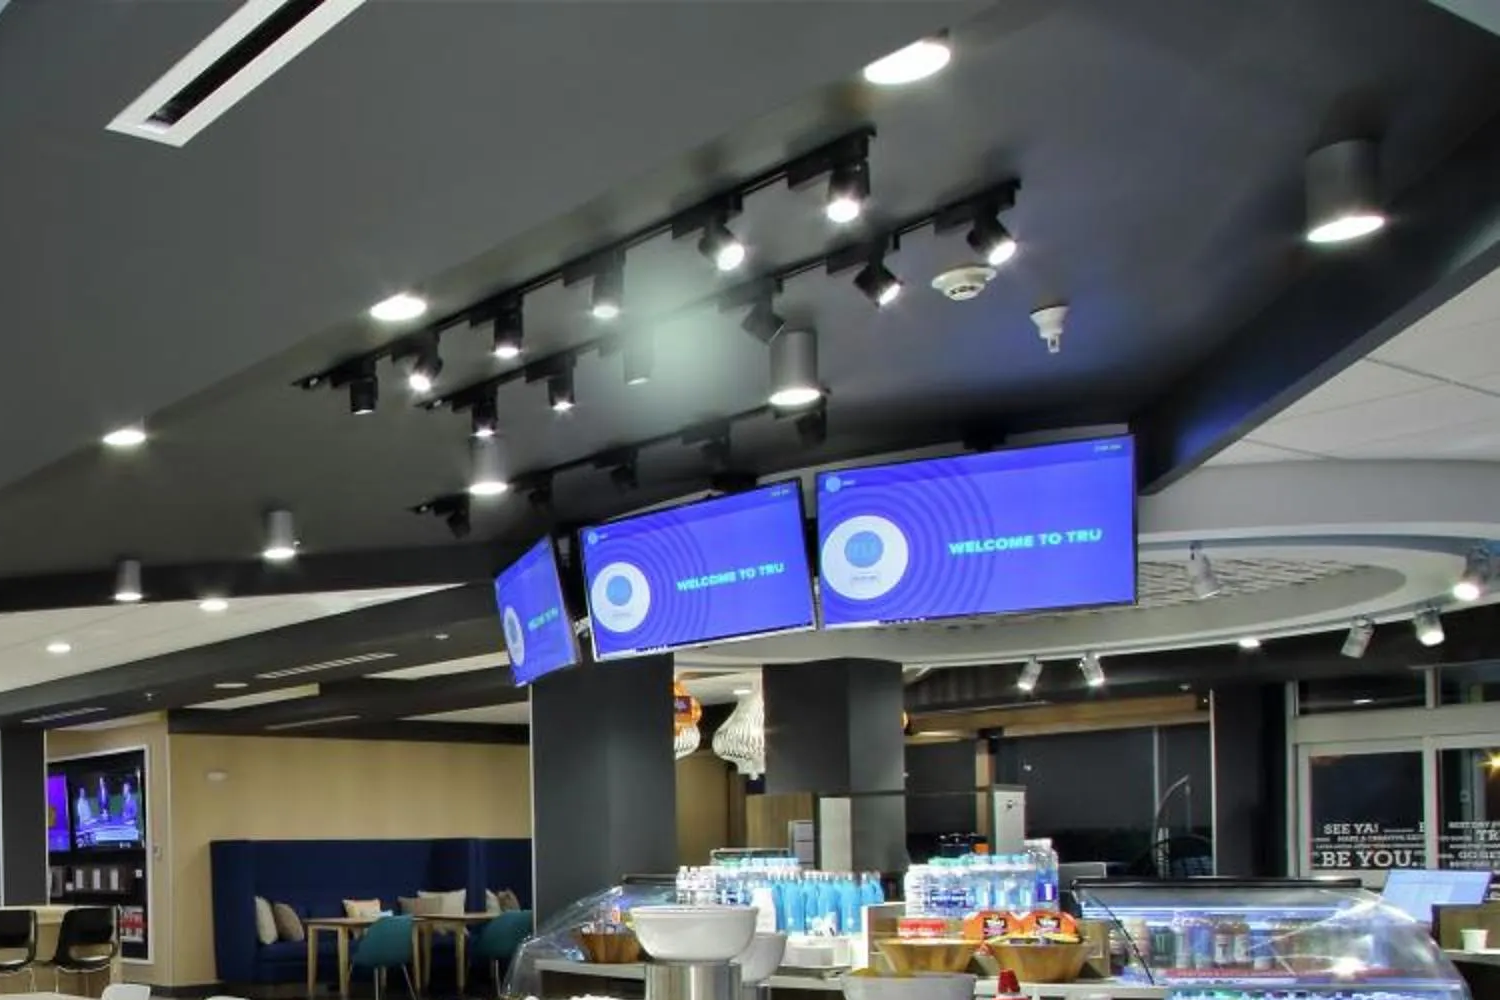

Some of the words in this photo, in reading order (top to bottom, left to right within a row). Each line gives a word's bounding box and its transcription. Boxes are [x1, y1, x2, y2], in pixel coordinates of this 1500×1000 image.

[949, 534, 1033, 555] WELCOME
[1040, 532, 1062, 546] TO
[1068, 528, 1103, 542] TRU
[676, 570, 737, 591] WELCOME
[740, 567, 755, 580] TO
[759, 562, 785, 576] TRU
[1323, 823, 1350, 835] SEE
[1353, 822, 1380, 834] YA!
[1320, 851, 1352, 867] BE
[1356, 849, 1418, 867] YOU.
